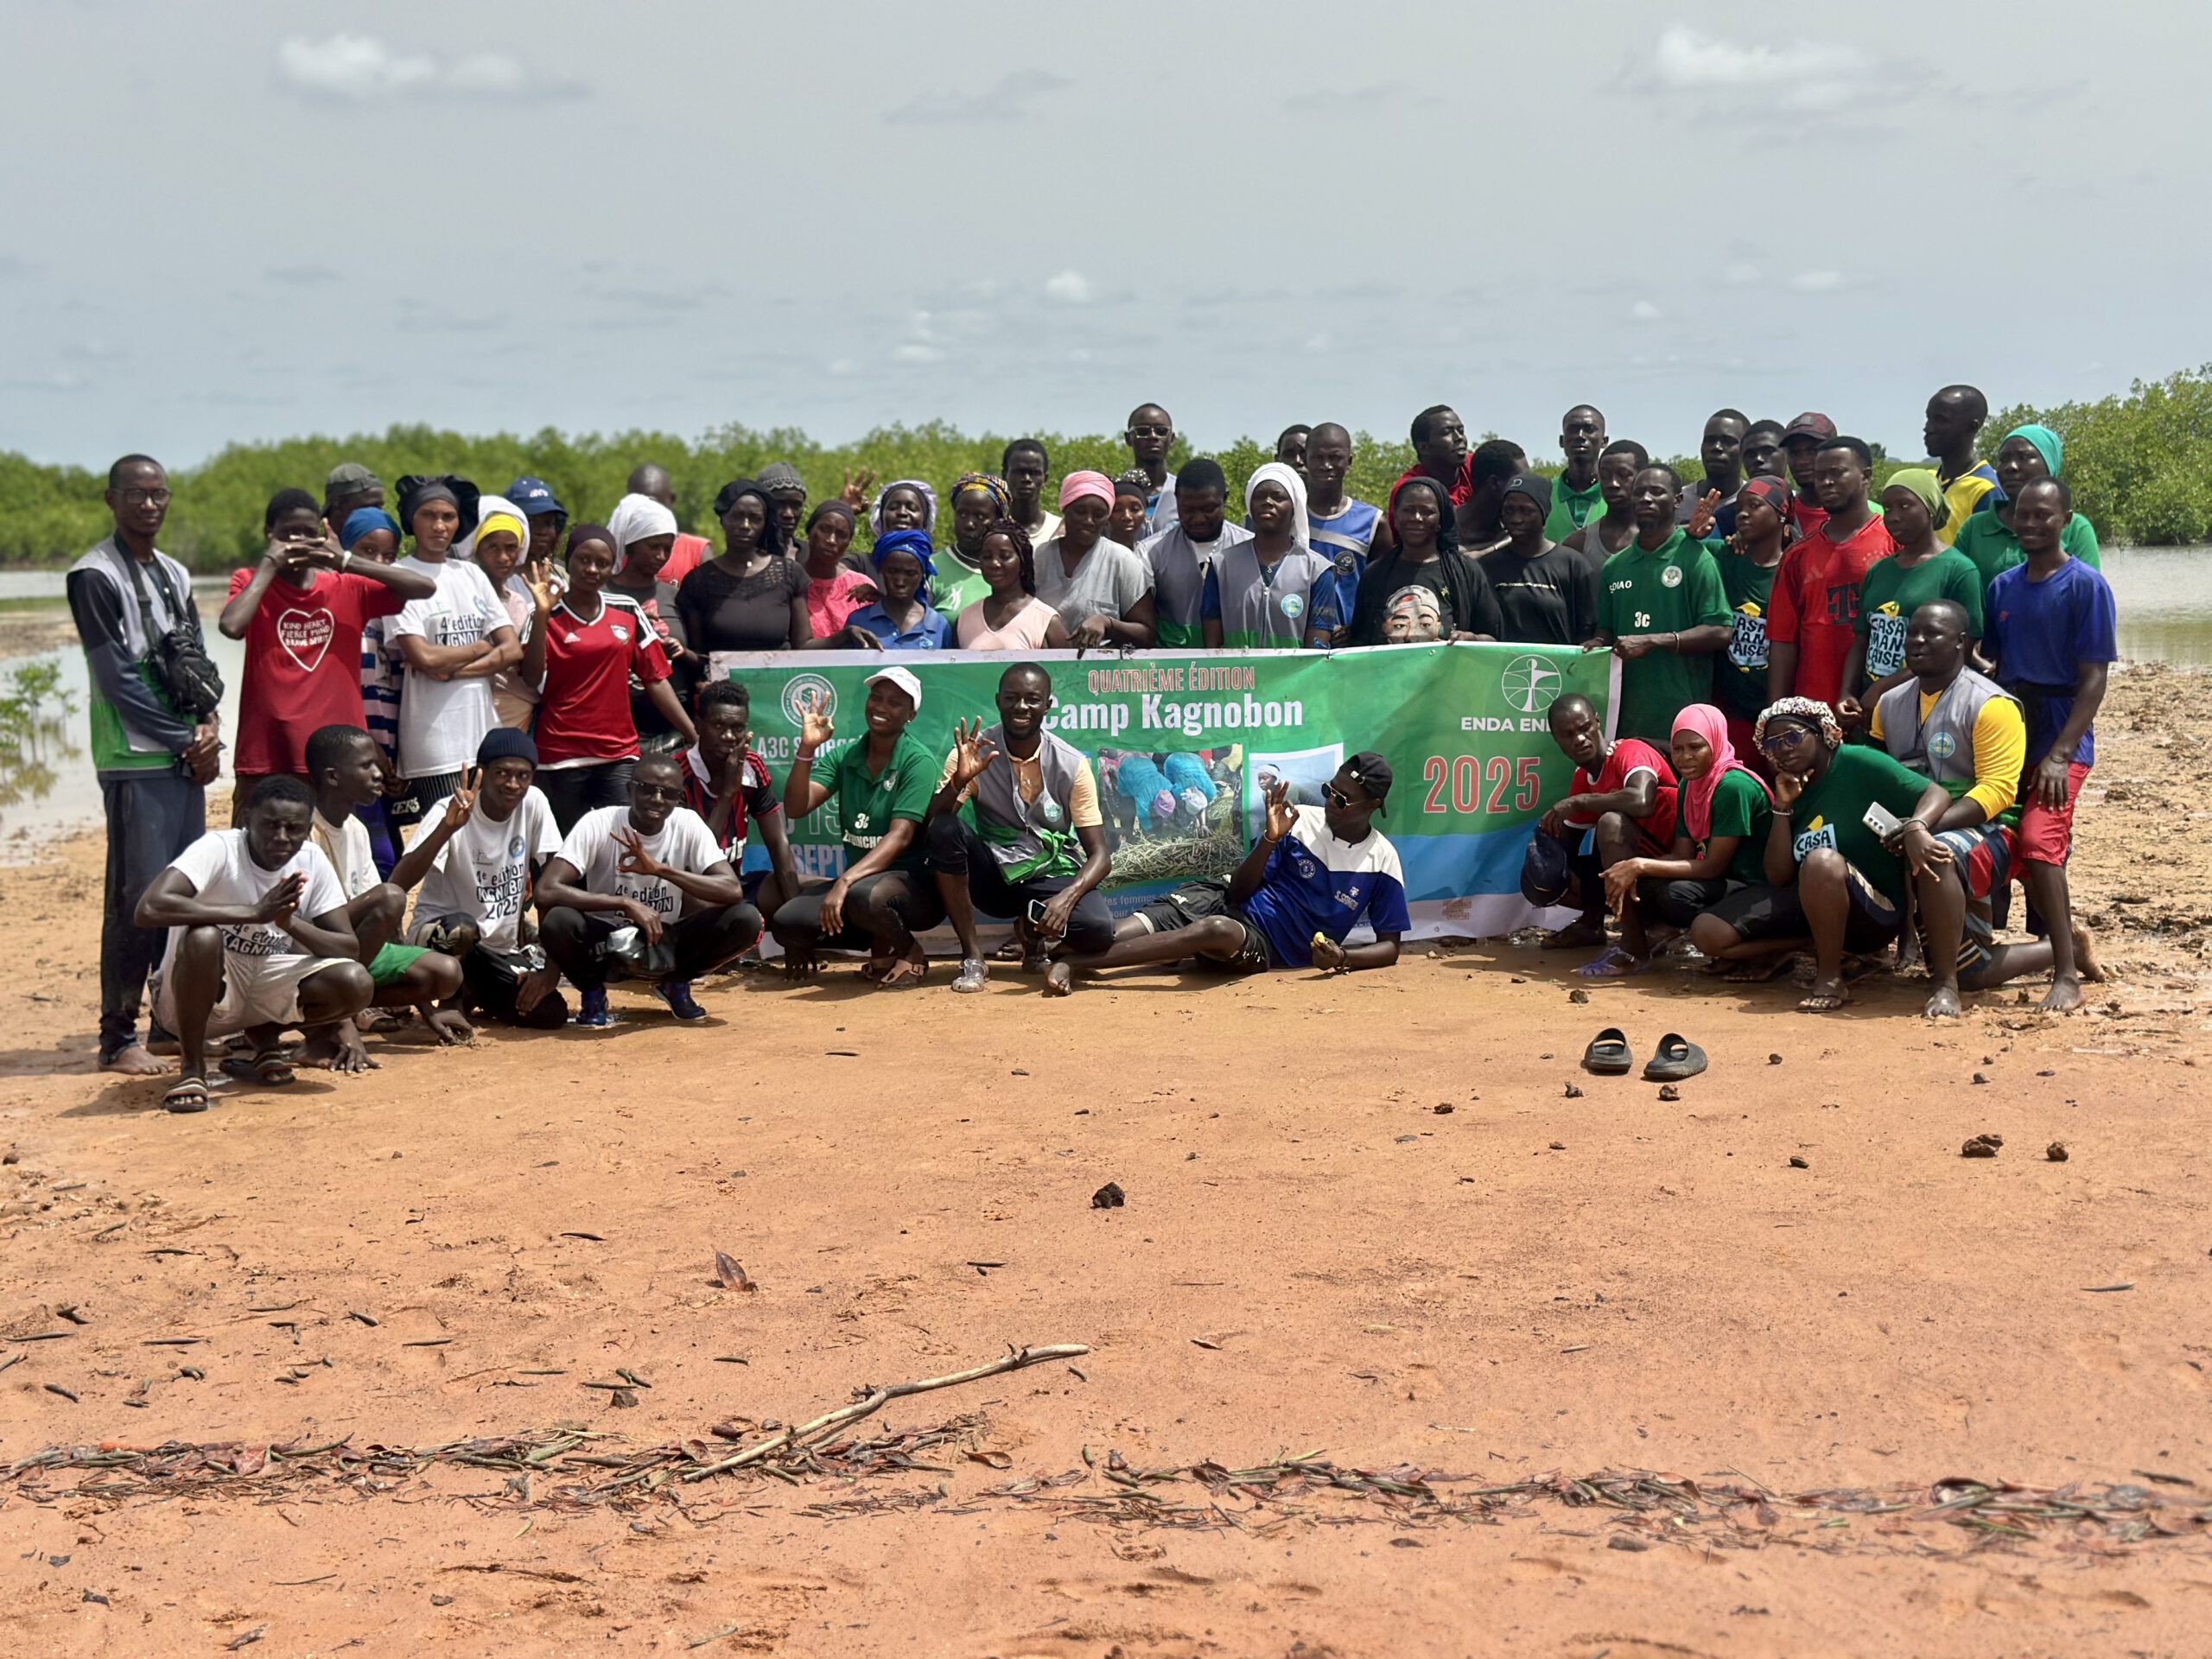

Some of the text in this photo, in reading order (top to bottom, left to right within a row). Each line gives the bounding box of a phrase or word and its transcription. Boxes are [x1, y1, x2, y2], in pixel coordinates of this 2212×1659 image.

[304, 619, 326, 630] HEART
[1871, 617, 1904, 638] CASA
[1730, 641, 1765, 657] AISE
[1872, 631, 1903, 652] MAN
[1868, 646, 1901, 668] CAISE
[1088, 662, 1255, 696] QUATRIÈME ÉDITION
[1040, 693, 1303, 736] Camp Kagnobon
[1461, 717, 1515, 731] ENDA
[757, 736, 789, 759] A3C
[1423, 754, 1541, 814] 2025
[1796, 830, 1831, 852] CASA
[791, 843, 846, 878] SEPT
[486, 896, 518, 920] 2025
